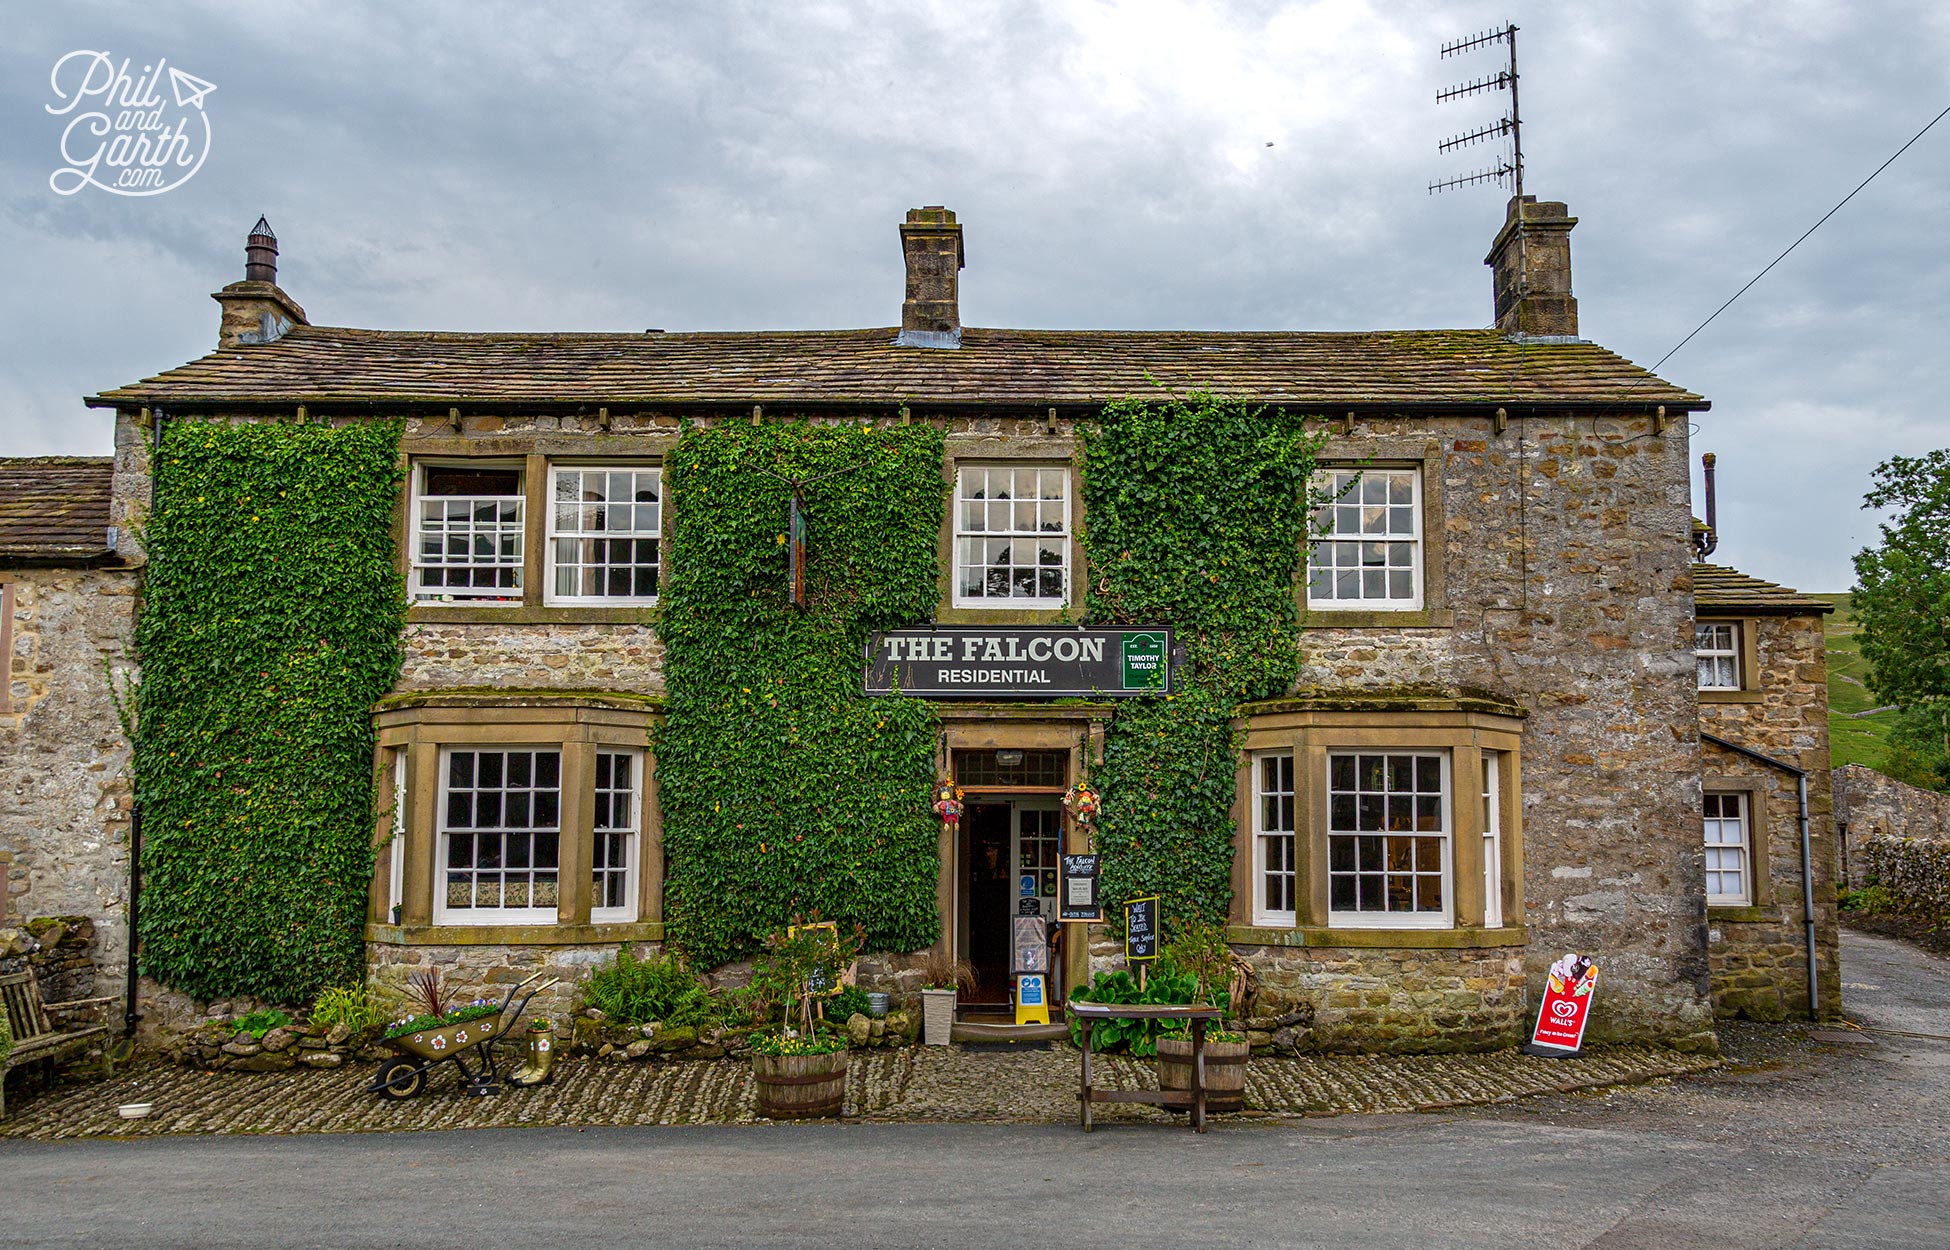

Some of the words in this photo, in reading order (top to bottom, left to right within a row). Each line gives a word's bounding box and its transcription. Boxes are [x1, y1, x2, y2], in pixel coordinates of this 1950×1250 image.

[884, 637, 952, 661] THE
[961, 637, 1105, 661] FALCON
[1130, 662, 1157, 670] TAYLOR
[937, 669, 1051, 684] RESIDENTIAL
[1550, 1016, 1574, 1027] WALL'S
